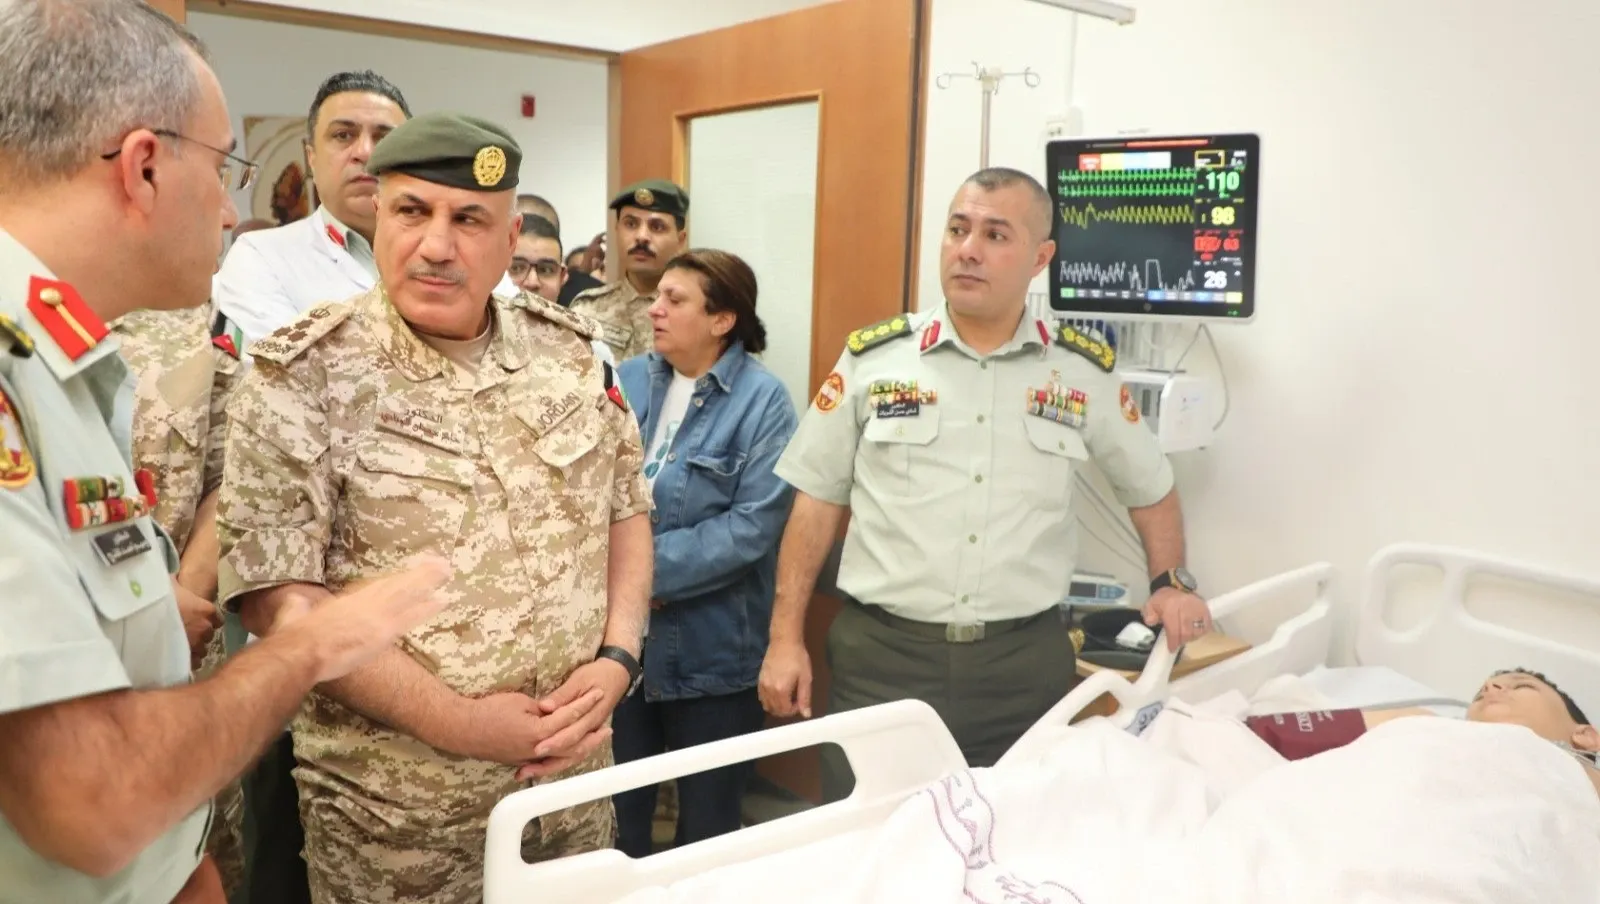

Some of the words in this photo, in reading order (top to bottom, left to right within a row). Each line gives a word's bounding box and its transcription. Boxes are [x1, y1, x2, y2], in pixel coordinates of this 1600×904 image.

[1206, 171, 1240, 191] 110
[1204, 270, 1227, 289] 26
[536, 392, 580, 430] JORDAN
